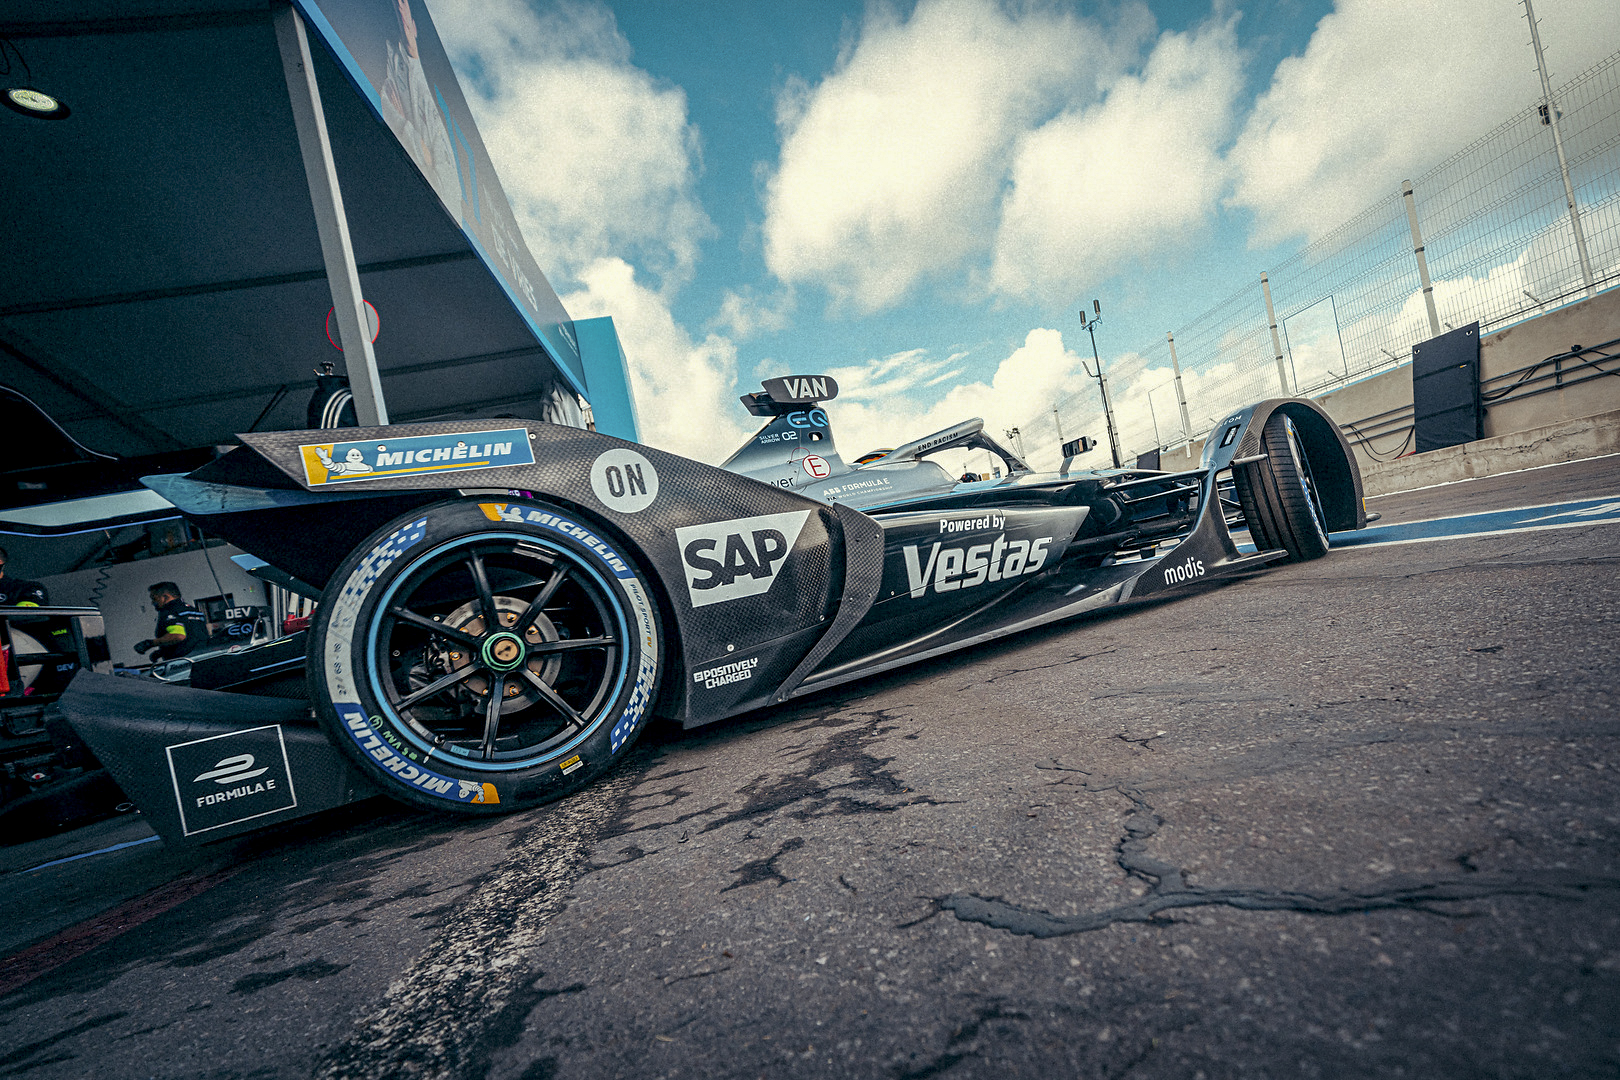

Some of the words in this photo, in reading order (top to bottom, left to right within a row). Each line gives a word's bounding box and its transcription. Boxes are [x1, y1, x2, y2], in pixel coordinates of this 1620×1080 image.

[783, 377, 828, 399] VAN
[787, 409, 829, 429] EQ
[781, 431, 798, 441] 02
[917, 441, 932, 451] END
[933, 432, 958, 446] RACISM
[376, 442, 513, 467] MICHELIN
[807, 457, 826, 477] E
[605, 463, 648, 498] ON
[823, 486, 841, 496] ABB
[841, 479, 883, 491] FORMULA
[882, 477, 890, 485] E
[939, 515, 990, 534] Powered
[992, 514, 1006, 530] by
[526, 510, 627, 573] MICHELIN
[684, 528, 788, 590] SAP
[902, 532, 1053, 599] Vestas
[1164, 556, 1205, 585] modis
[225, 606, 251, 620] DEV
[630, 583, 645, 606] PILOT
[640, 605, 652, 635] SPORT
[646, 636, 653, 649] EV
[703, 657, 759, 680] POSITIVELY
[704, 669, 752, 690] CHARGED
[382, 730, 402, 750] VAN
[343, 712, 454, 794] MICHELIN
[196, 782, 265, 808] FORMULA
[266, 779, 276, 791] E
